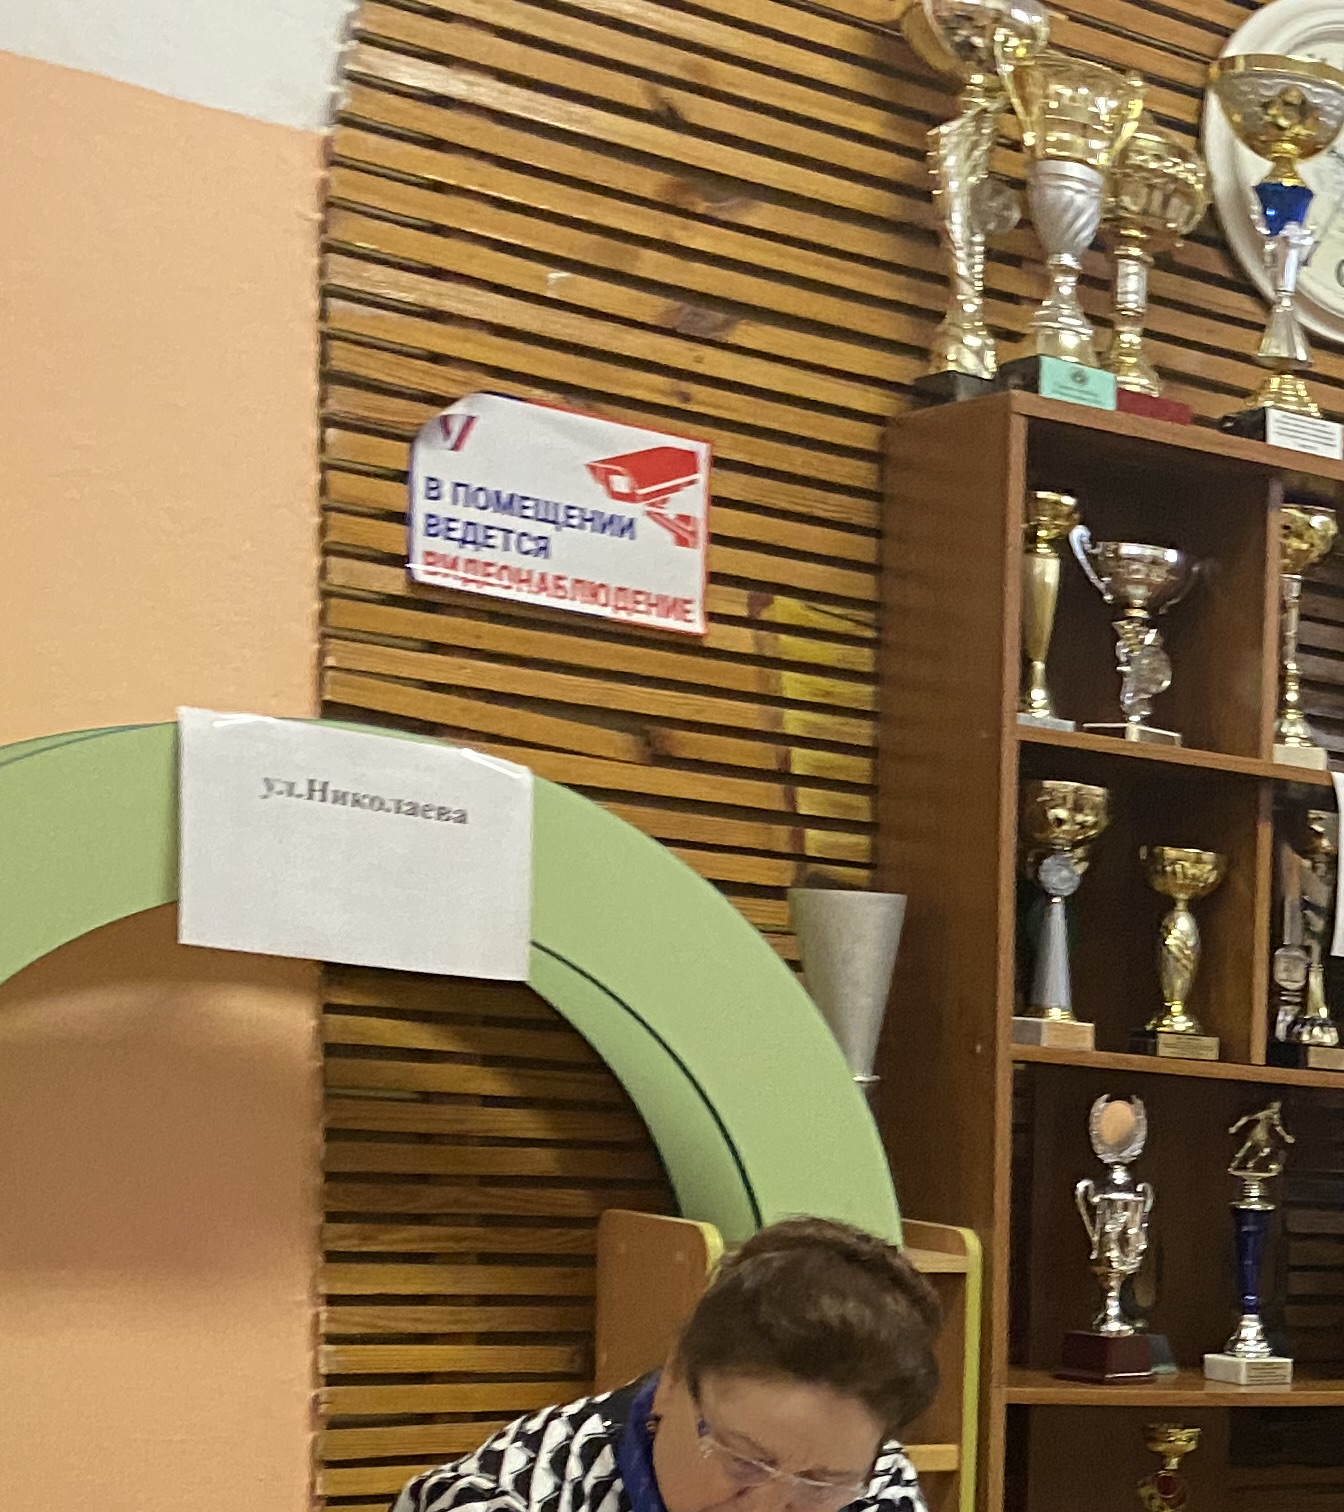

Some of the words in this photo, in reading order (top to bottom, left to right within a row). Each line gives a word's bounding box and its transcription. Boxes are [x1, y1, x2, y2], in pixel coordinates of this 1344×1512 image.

[424, 475, 442, 501] В
[451, 481, 637, 541] ПОМЕЩЕНИИ
[423, 513, 551, 560] ВЕДЕТСЯ
[259, 776, 470, 825] ул.Николаева
